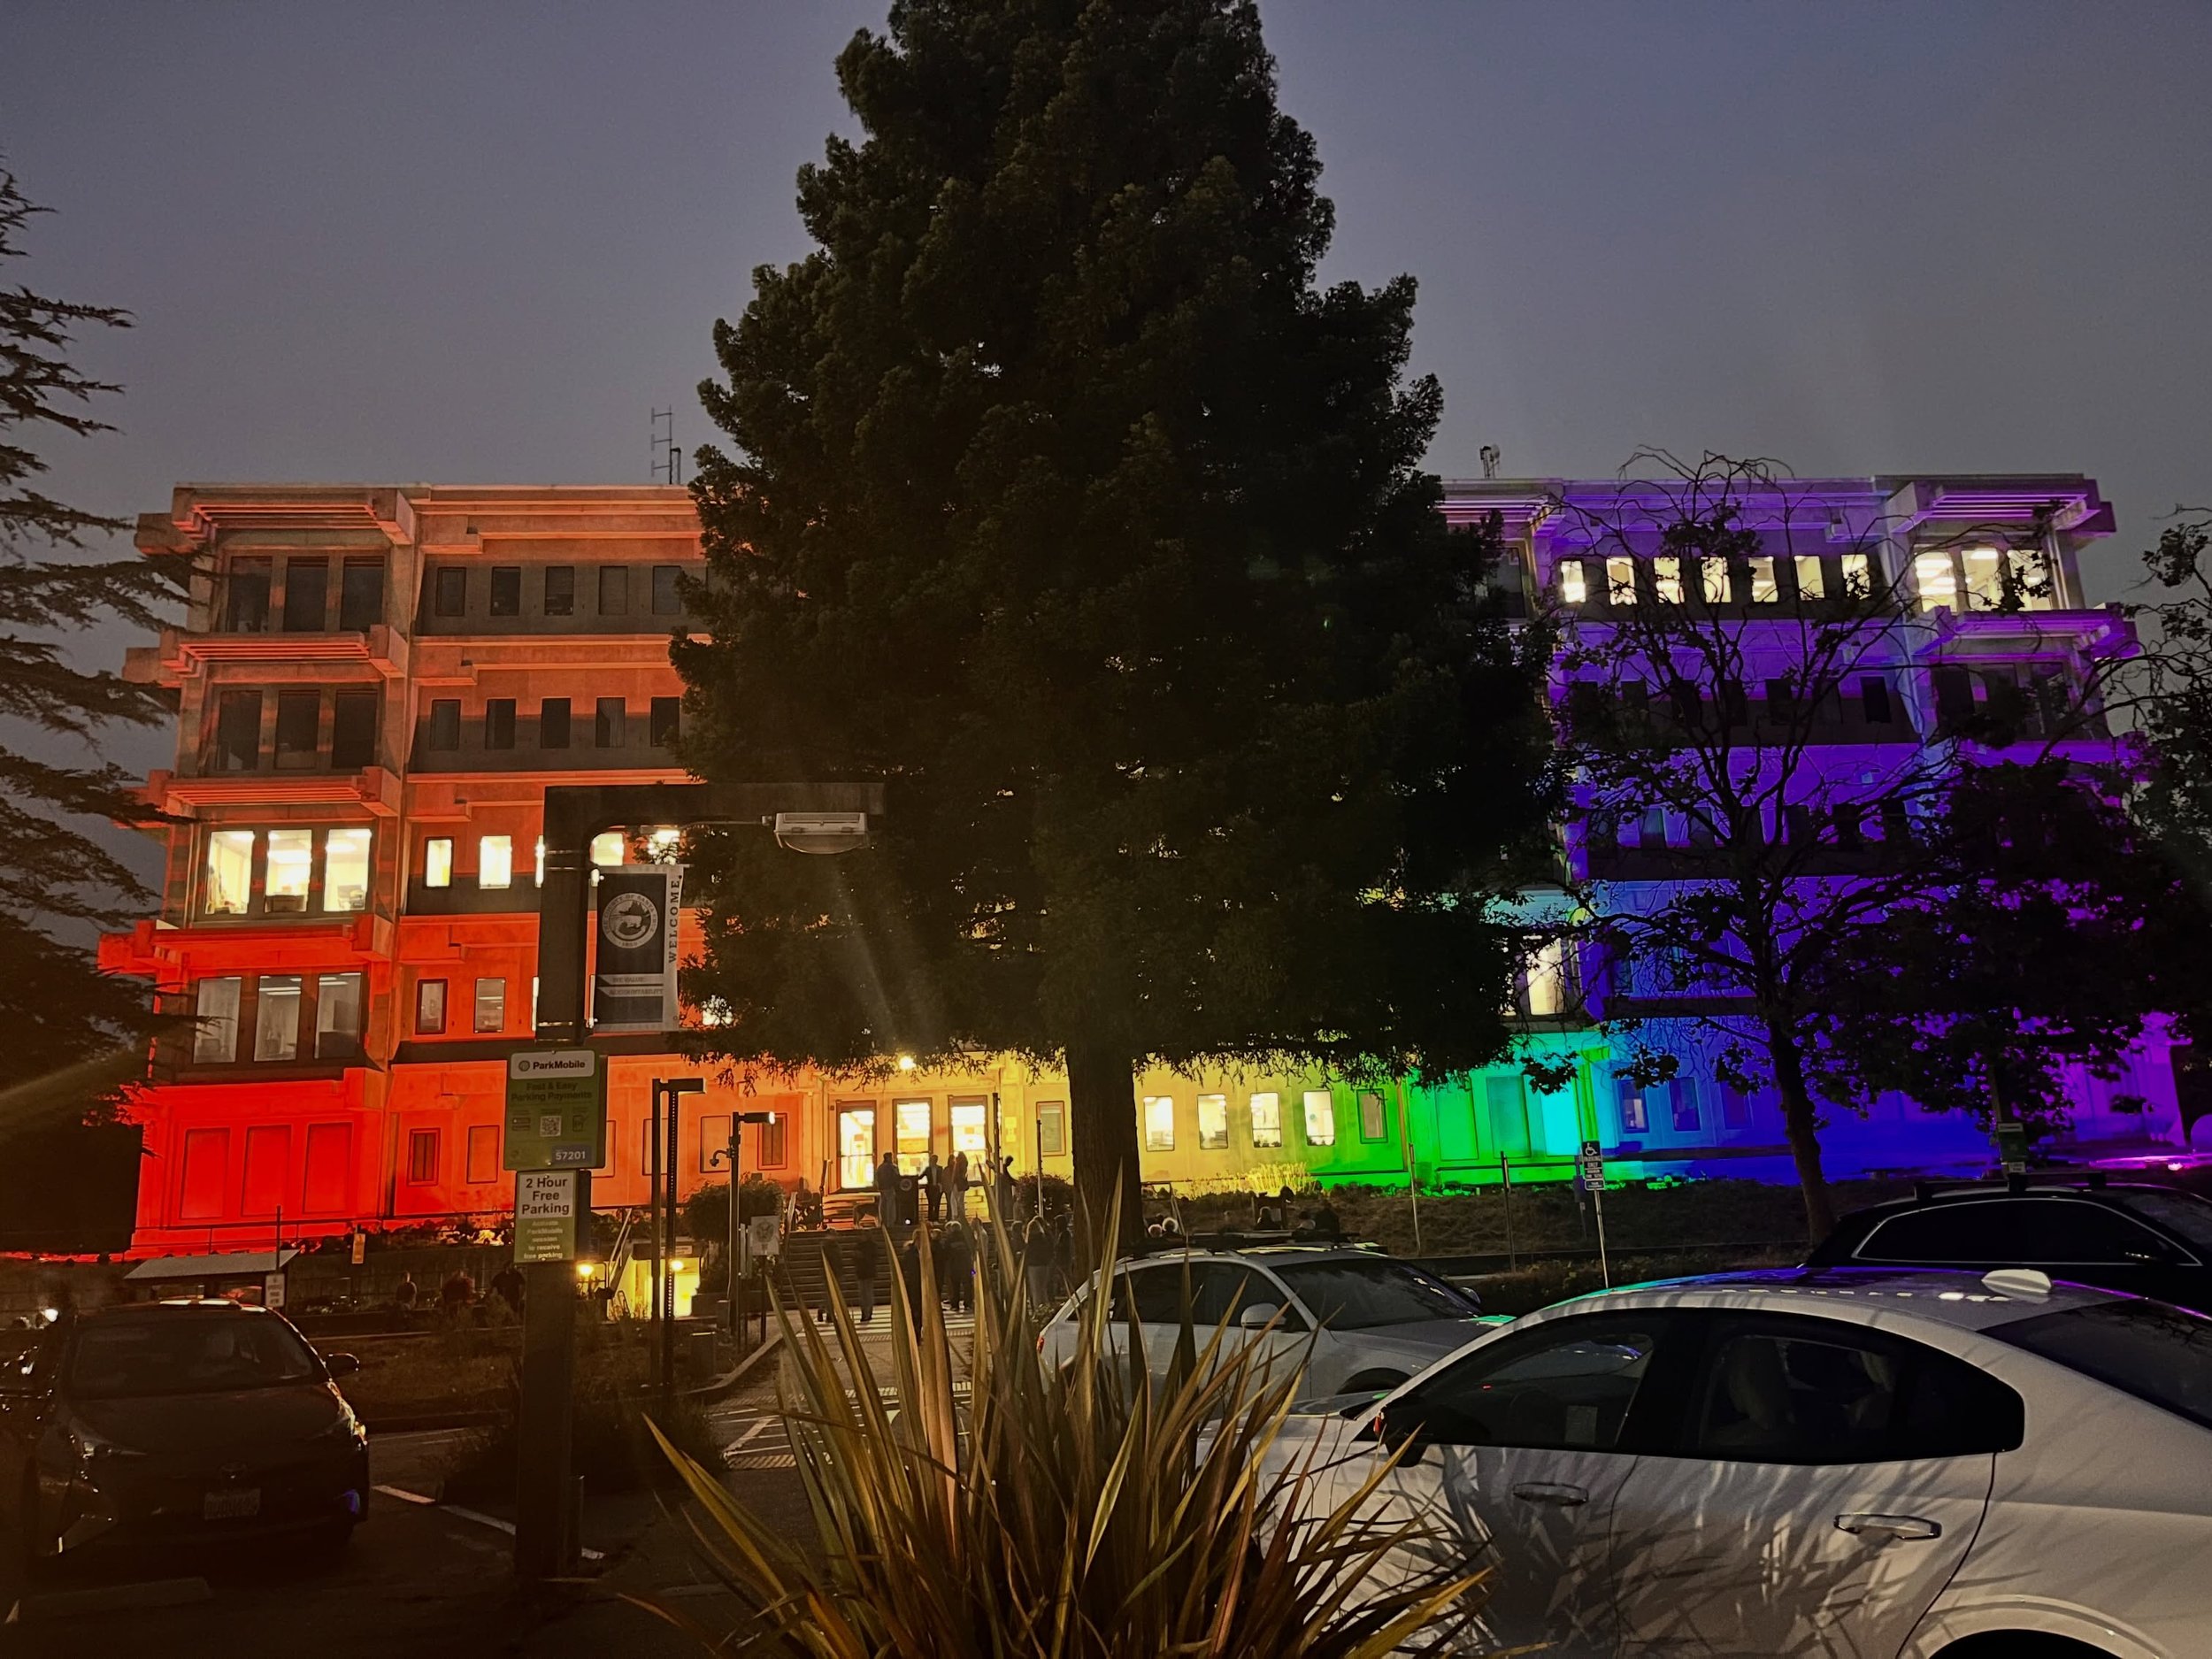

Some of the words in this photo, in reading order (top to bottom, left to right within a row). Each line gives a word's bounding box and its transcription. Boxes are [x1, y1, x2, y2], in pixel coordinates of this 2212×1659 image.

[533, 1060, 586, 1070] ParkMobile
[557, 1081, 578, 1091] Easy
[511, 1093, 546, 1102] Parking
[548, 1091, 593, 1102] Payments
[556, 1151, 586, 1161] 57201
[526, 1178, 533, 1188] 2
[537, 1177, 568, 1187] Hour
[532, 1190, 560, 1201] Free
[521, 1202, 569, 1215] Parking
